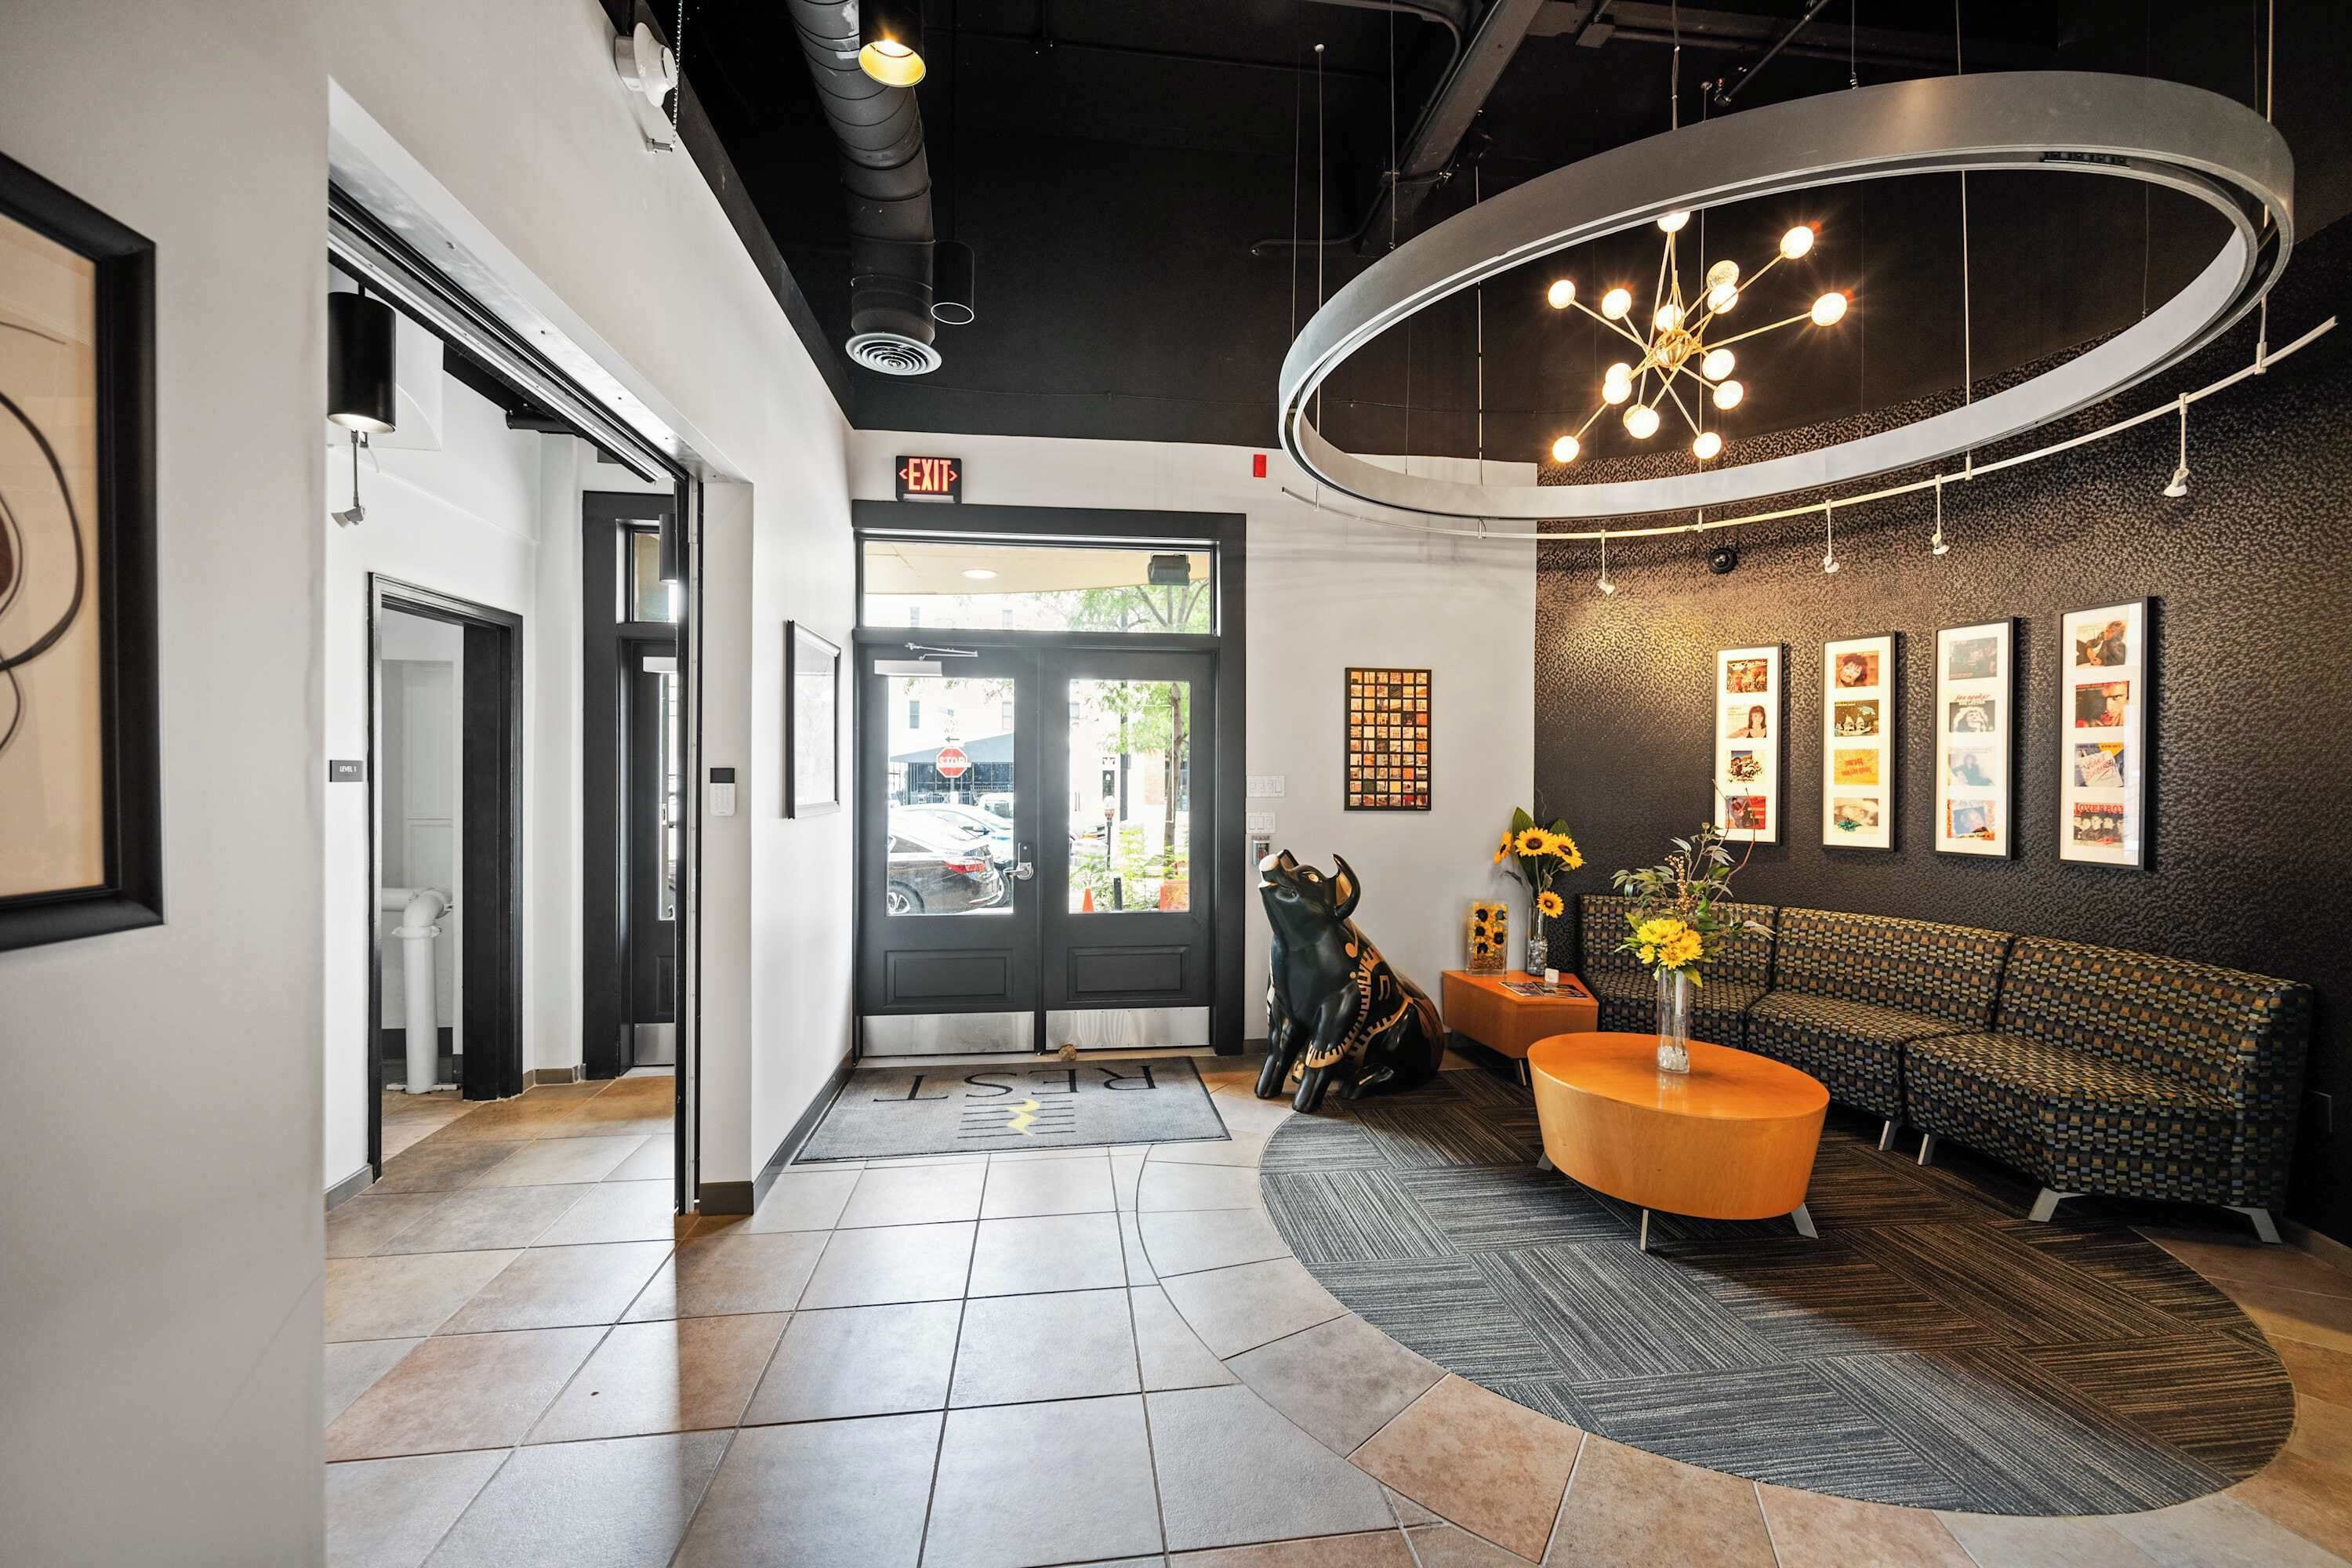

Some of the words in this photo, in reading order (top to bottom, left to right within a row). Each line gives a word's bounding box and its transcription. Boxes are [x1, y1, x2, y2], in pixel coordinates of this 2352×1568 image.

[908, 458, 952, 492] EXIT
[938, 756, 966, 767] STOP
[873, 1065, 1156, 1102] REST
